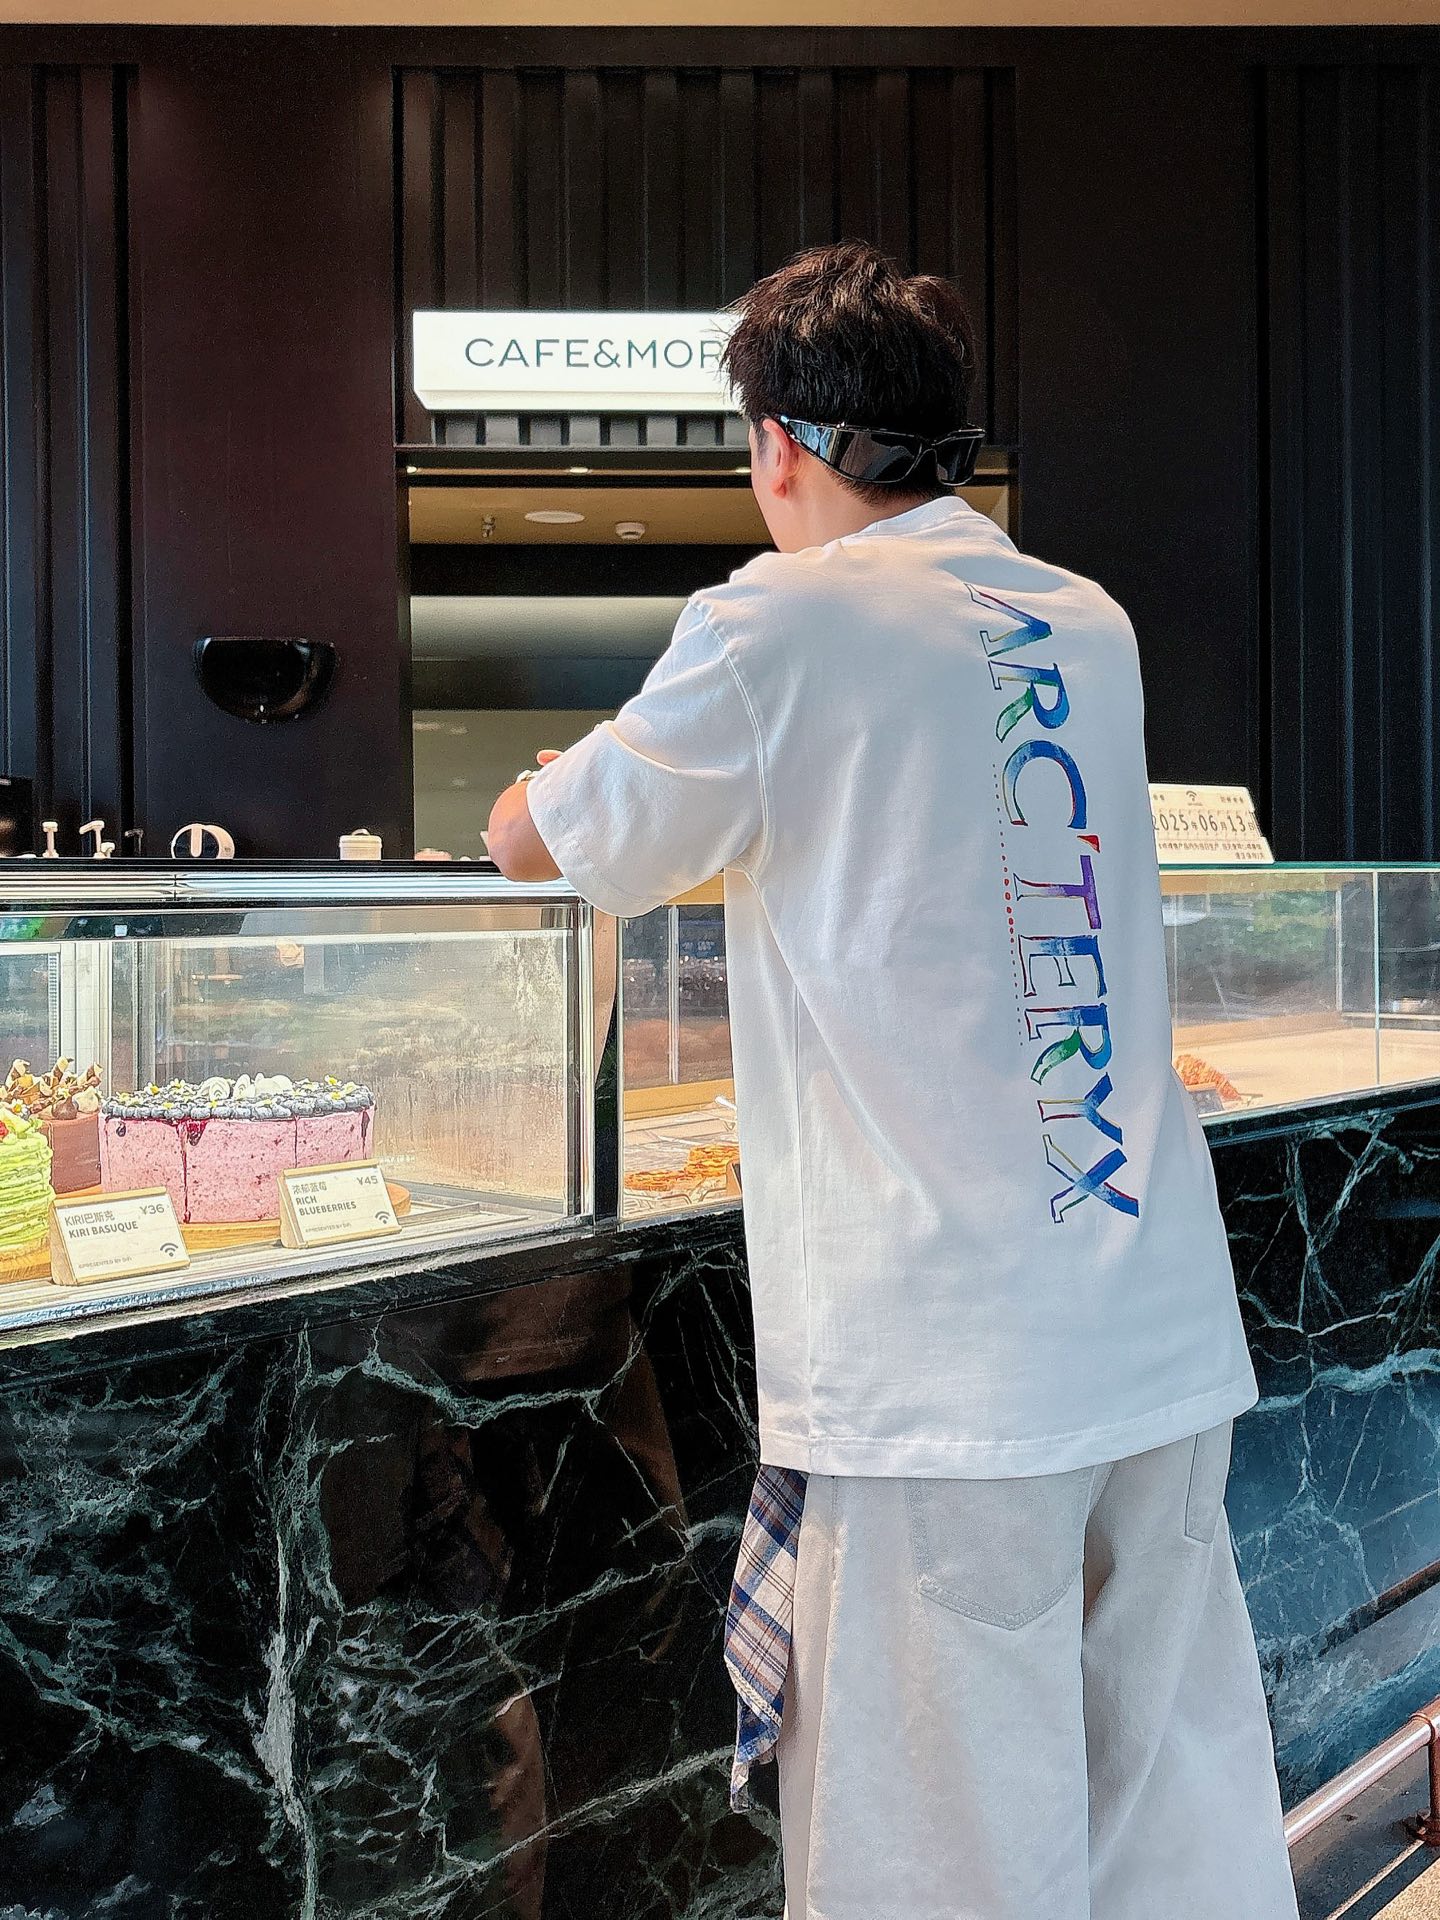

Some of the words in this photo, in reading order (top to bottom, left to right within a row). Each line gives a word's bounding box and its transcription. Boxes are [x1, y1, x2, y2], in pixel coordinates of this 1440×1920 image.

[464, 338, 723, 369] CAFE&MOR
[964, 583, 1139, 1224] ARC'TERYX
[295, 1195, 318, 1206] RICH
[298, 1201, 357, 1216] BLUEBERRIES
[64, 1210, 115, 1227] KIRI巴斯克
[68, 1226, 91, 1239] KIRI
[92, 1220, 139, 1236] BASUQUE
